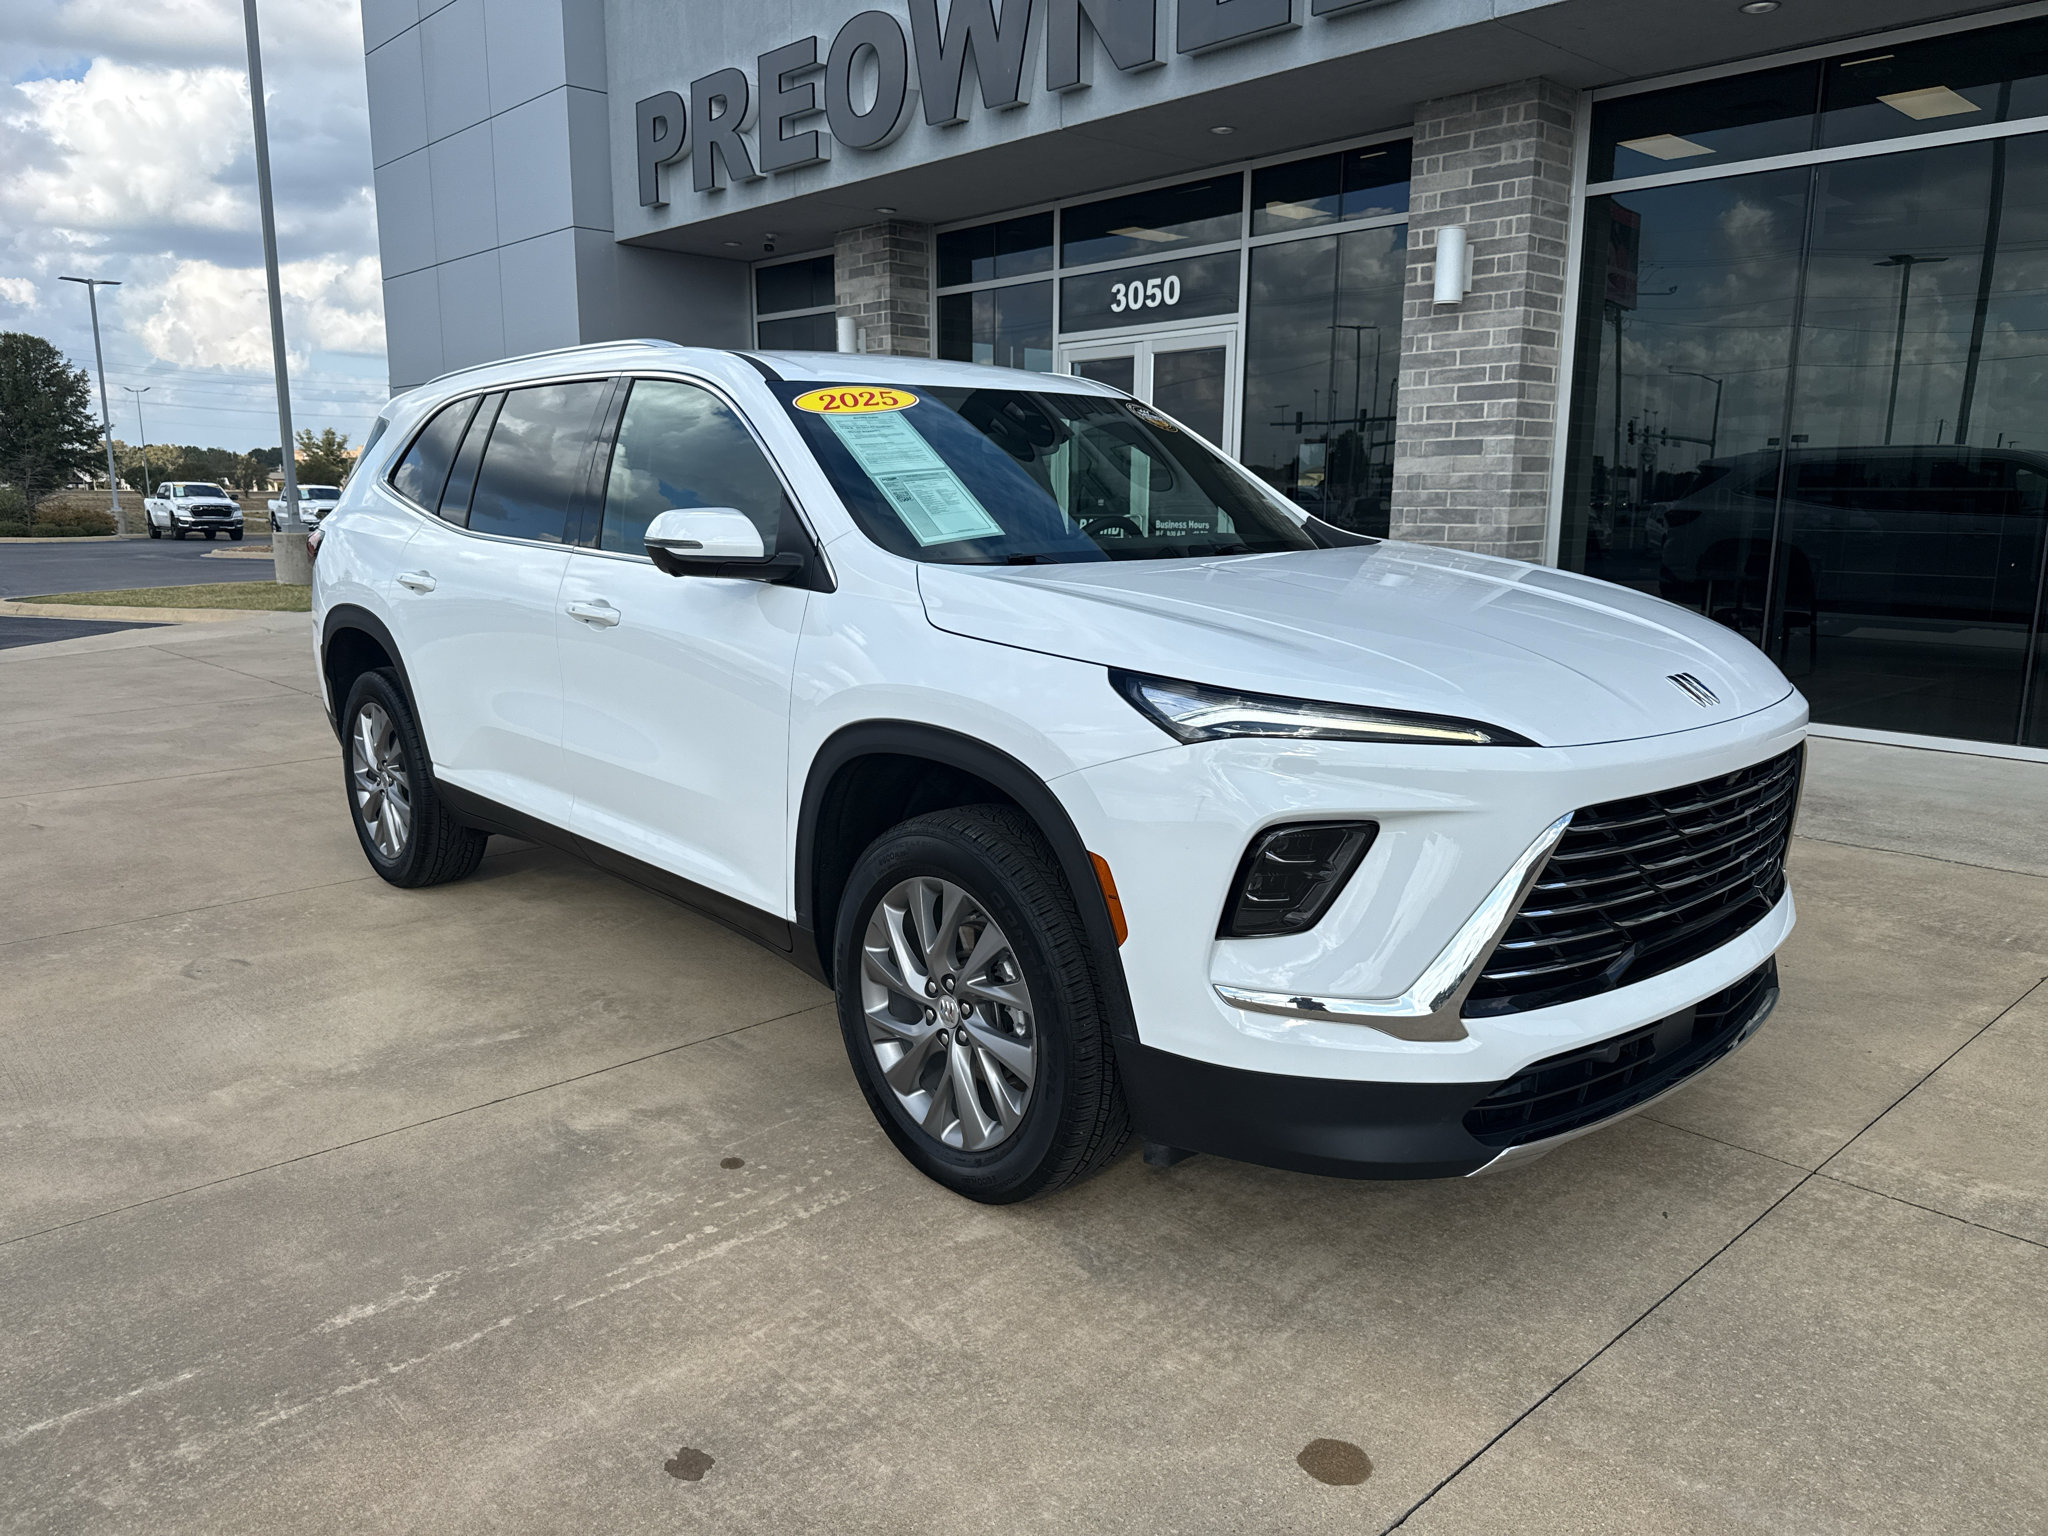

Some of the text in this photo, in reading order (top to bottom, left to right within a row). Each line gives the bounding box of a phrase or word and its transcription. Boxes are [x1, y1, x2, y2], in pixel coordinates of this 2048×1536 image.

[636, 0, 1392, 207] PREOWN
[1110, 275, 1181, 313] 3050
[818, 391, 899, 411] 2025
[1155, 520, 1210, 530] Business Hours
